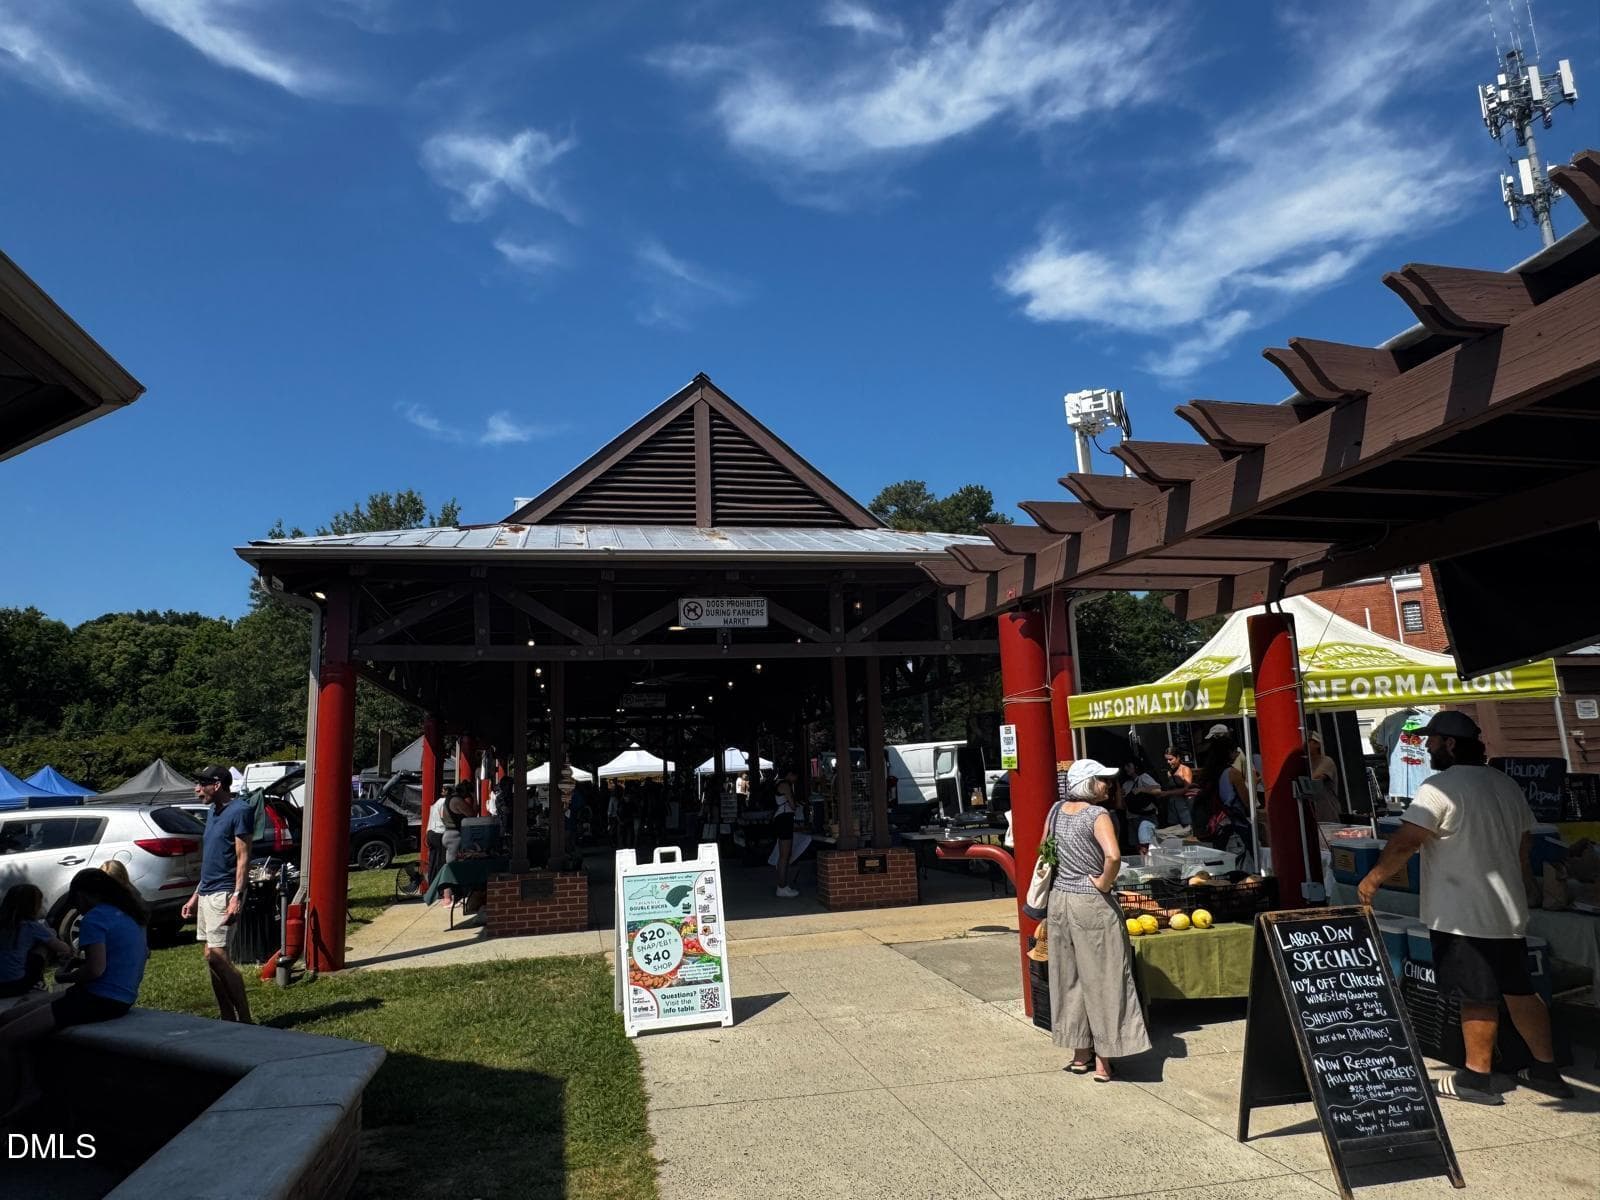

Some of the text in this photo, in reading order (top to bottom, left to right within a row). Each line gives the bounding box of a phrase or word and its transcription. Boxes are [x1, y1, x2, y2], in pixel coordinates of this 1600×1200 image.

[706, 599, 765, 608] DOGS PROHIBITED
[706, 608, 764, 617] DURING FARMERS
[722, 617, 751, 625] MARKET
[1088, 688, 1210, 720] INFORMATION
[639, 928, 665, 944] $20
[1274, 924, 1354, 950] LABOR DAY
[636, 938, 672, 953] SNAP/EBT
[643, 949, 671, 966] $40
[1293, 938, 1381, 972] SPECIALS!
[653, 962, 673, 972] SHOP
[1291, 972, 1386, 994] 10% OFF CHICKEN
[660, 990, 697, 1000] Questions?
[1305, 992, 1332, 1004] WINGS
[1355, 1003, 1363, 1011] 2
[1301, 1007, 1354, 1028] SHISHITOS
[1324, 1065, 1417, 1088] HOLIDAY TURKEYS
[1352, 1109, 1376, 1124] Spray
[1388, 1104, 1403, 1115] ALL
